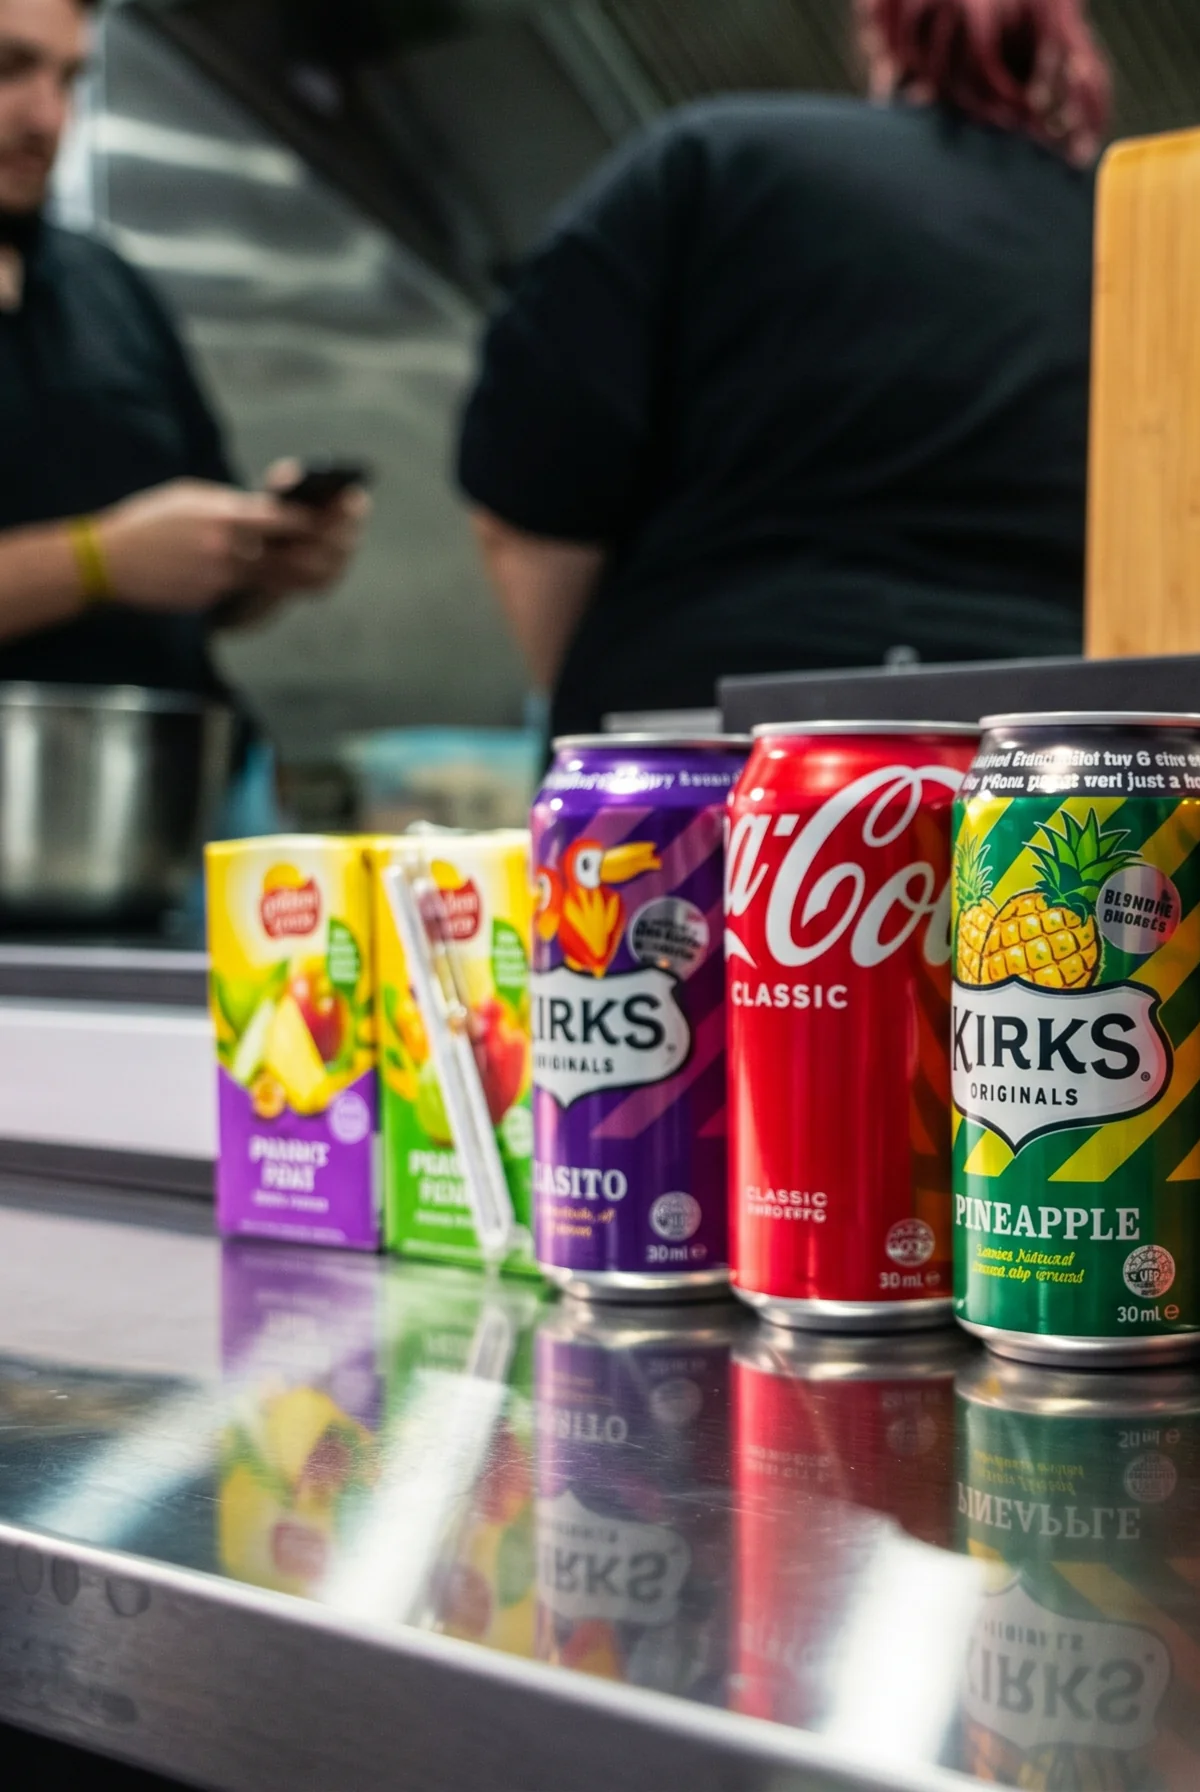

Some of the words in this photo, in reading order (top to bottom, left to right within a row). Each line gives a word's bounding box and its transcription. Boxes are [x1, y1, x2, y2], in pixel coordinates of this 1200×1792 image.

[1126, 771, 1166, 792] just
[1169, 775, 1181, 789] a
[731, 980, 848, 1010] CLASSIC
[537, 992, 665, 1051] IRKS
[953, 1005, 1141, 1081] KIRKS
[970, 1082, 1079, 1107] ORIGINALS
[955, 1193, 1141, 1241] PINEAPPLE
